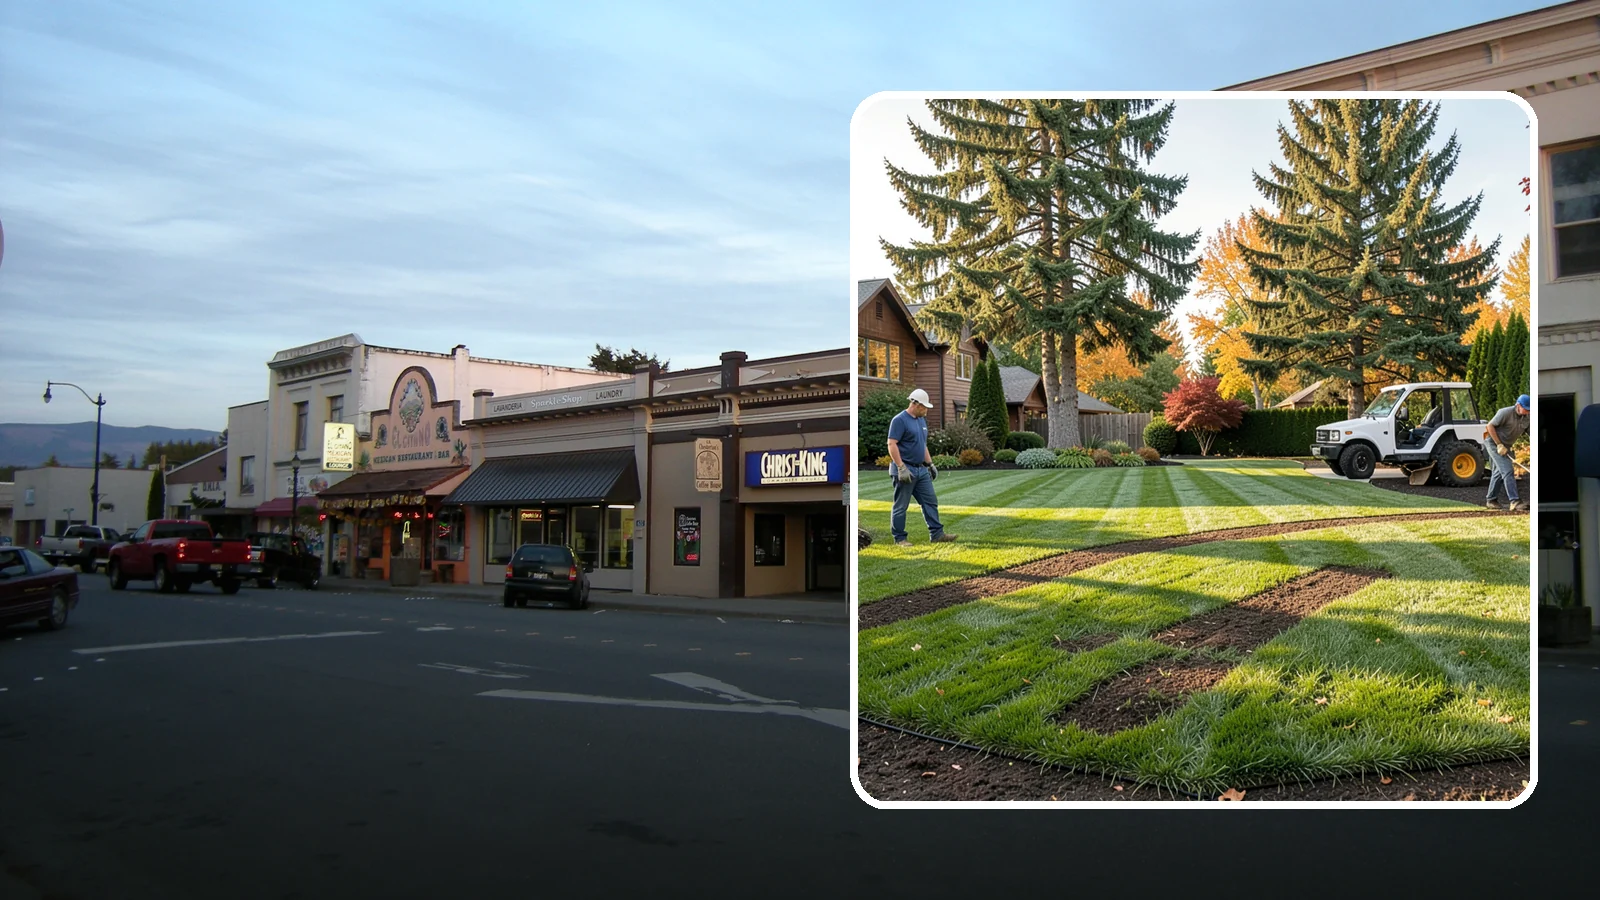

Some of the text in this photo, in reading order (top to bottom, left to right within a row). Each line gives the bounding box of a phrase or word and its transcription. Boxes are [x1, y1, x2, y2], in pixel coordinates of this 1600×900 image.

[493, 402, 522, 412] LAVANDERIA
[561, 394, 582, 405] Shop
[595, 389, 623, 399] LAUNDRY
[374, 455, 396, 464] MEXICAN
[398, 452, 433, 461] RESTAURANT
[438, 450, 450, 458] BAR
[760, 450, 827, 478] CHRIST KING
